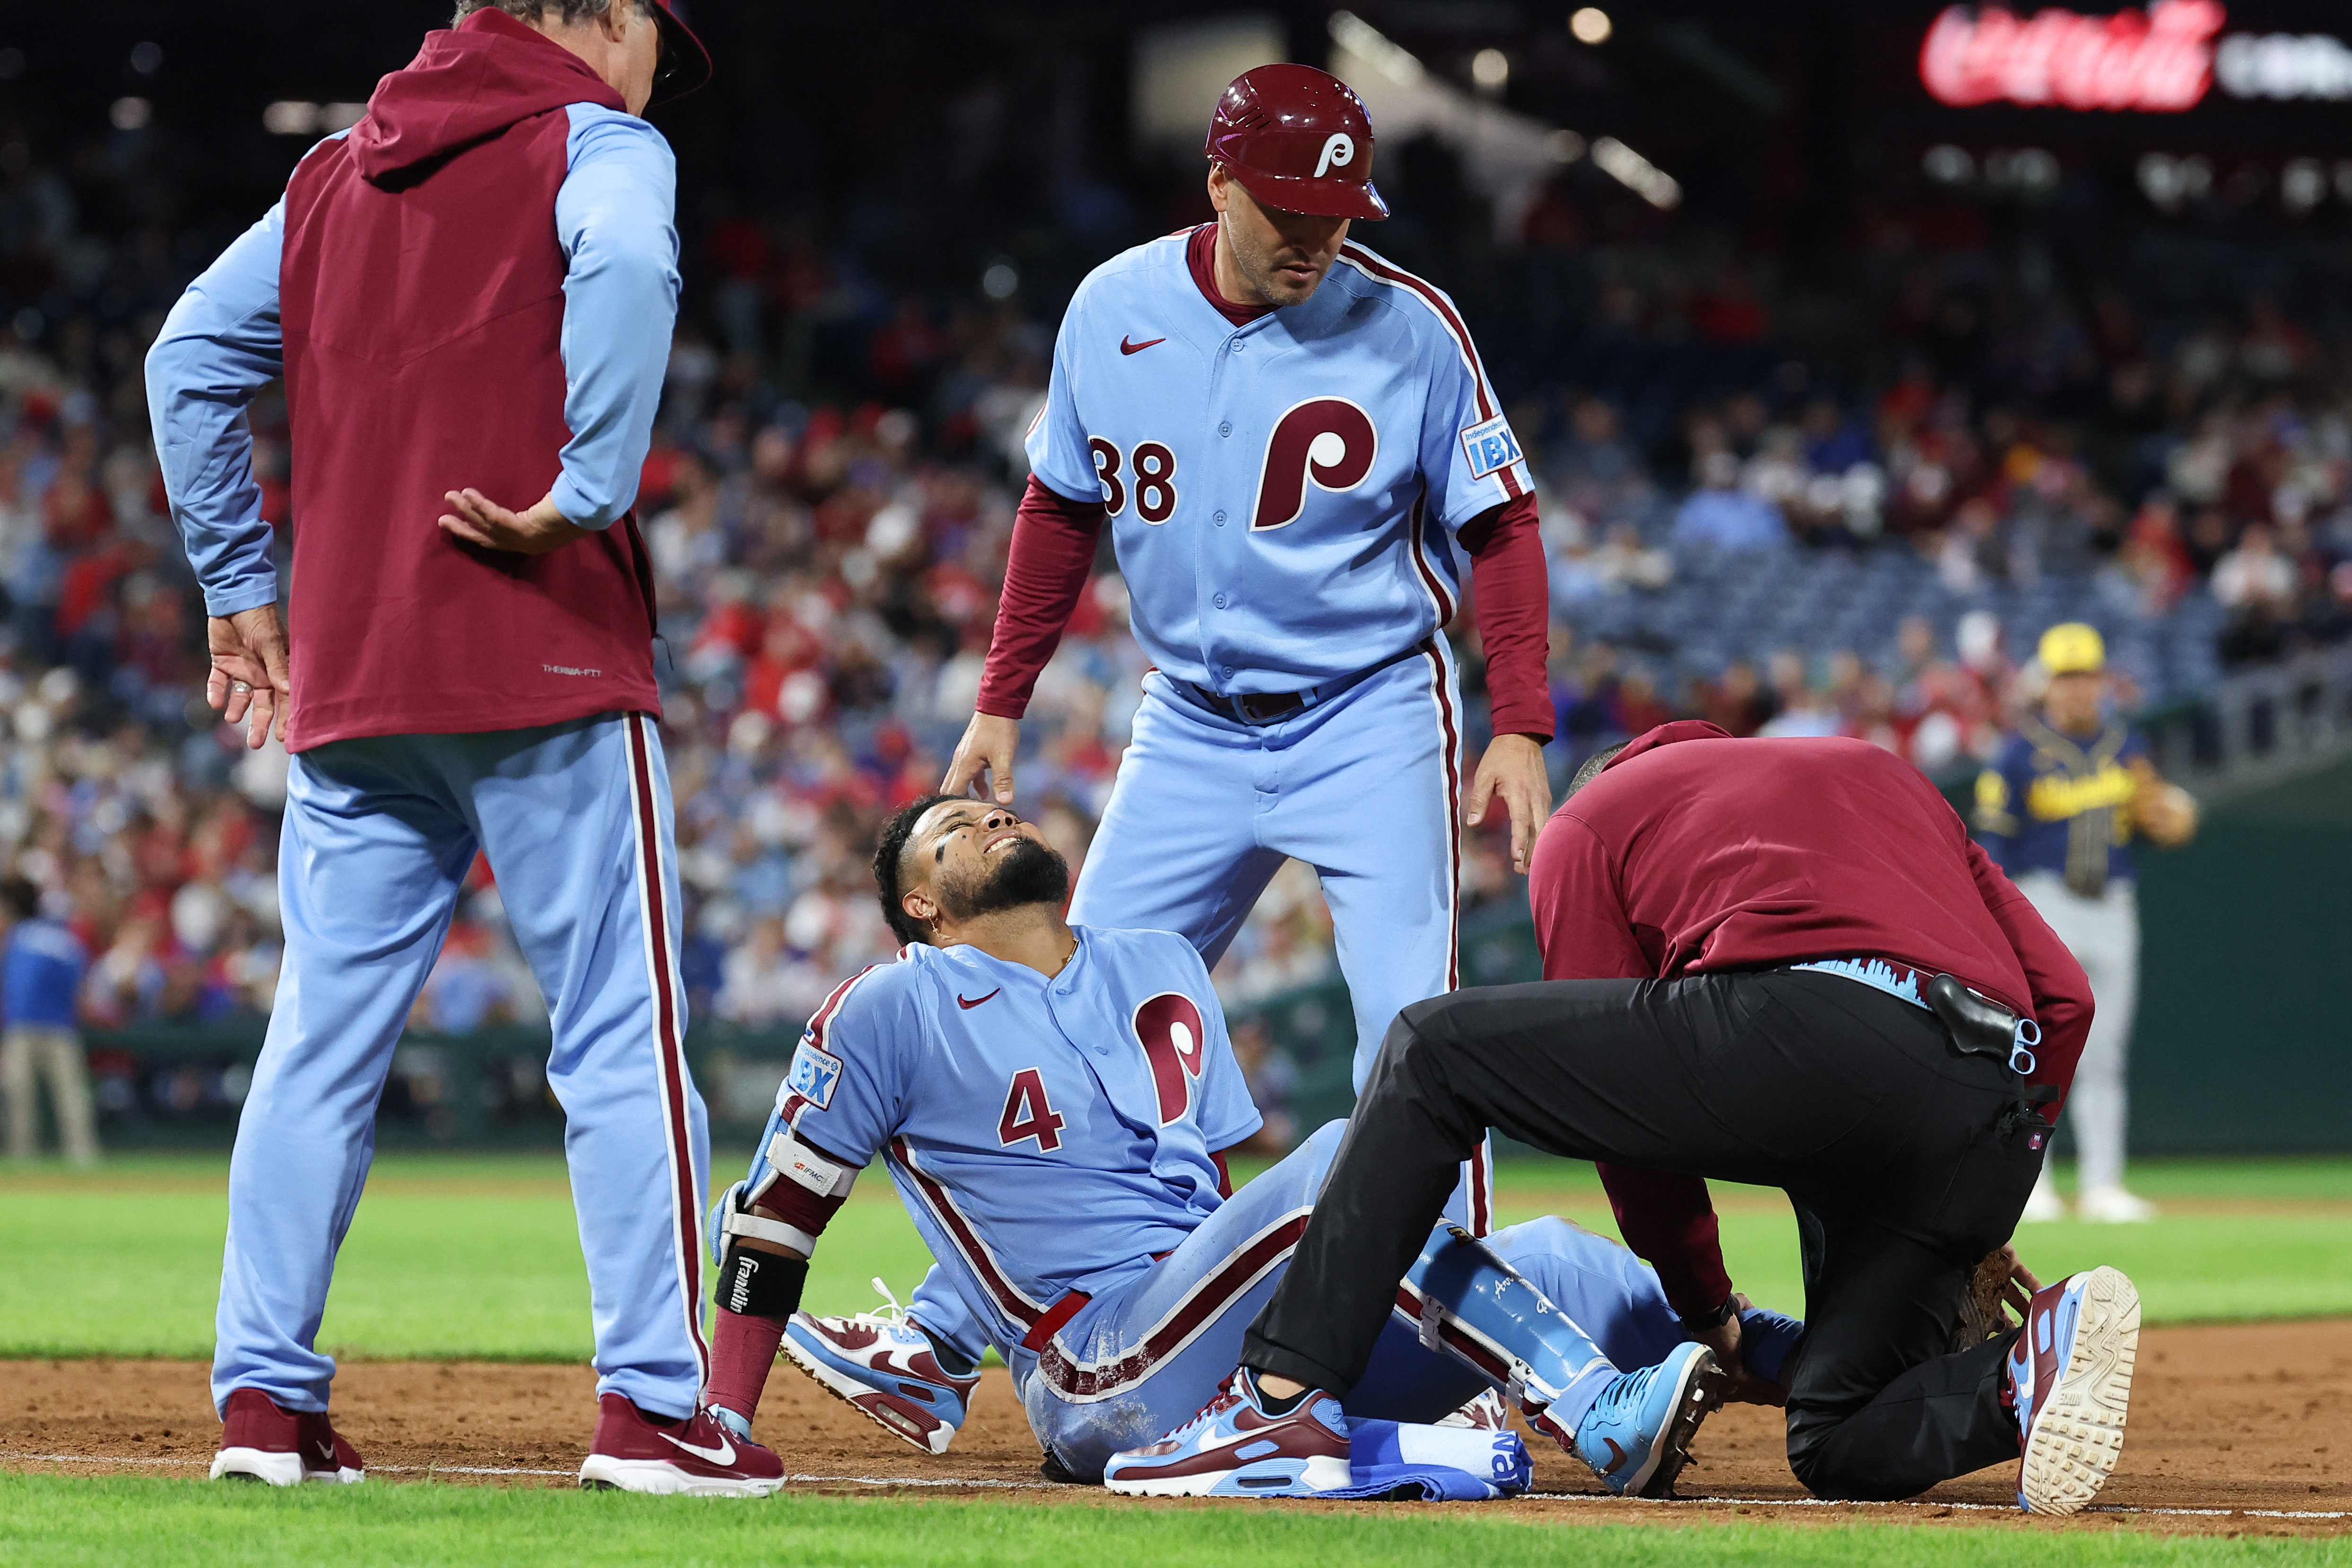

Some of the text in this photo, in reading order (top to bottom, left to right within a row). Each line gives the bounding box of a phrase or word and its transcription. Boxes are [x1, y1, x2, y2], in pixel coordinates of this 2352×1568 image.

[1088, 434, 1178, 526] 38
[1468, 428, 1520, 474] IBX
[997, 1066, 1067, 1154] 4
